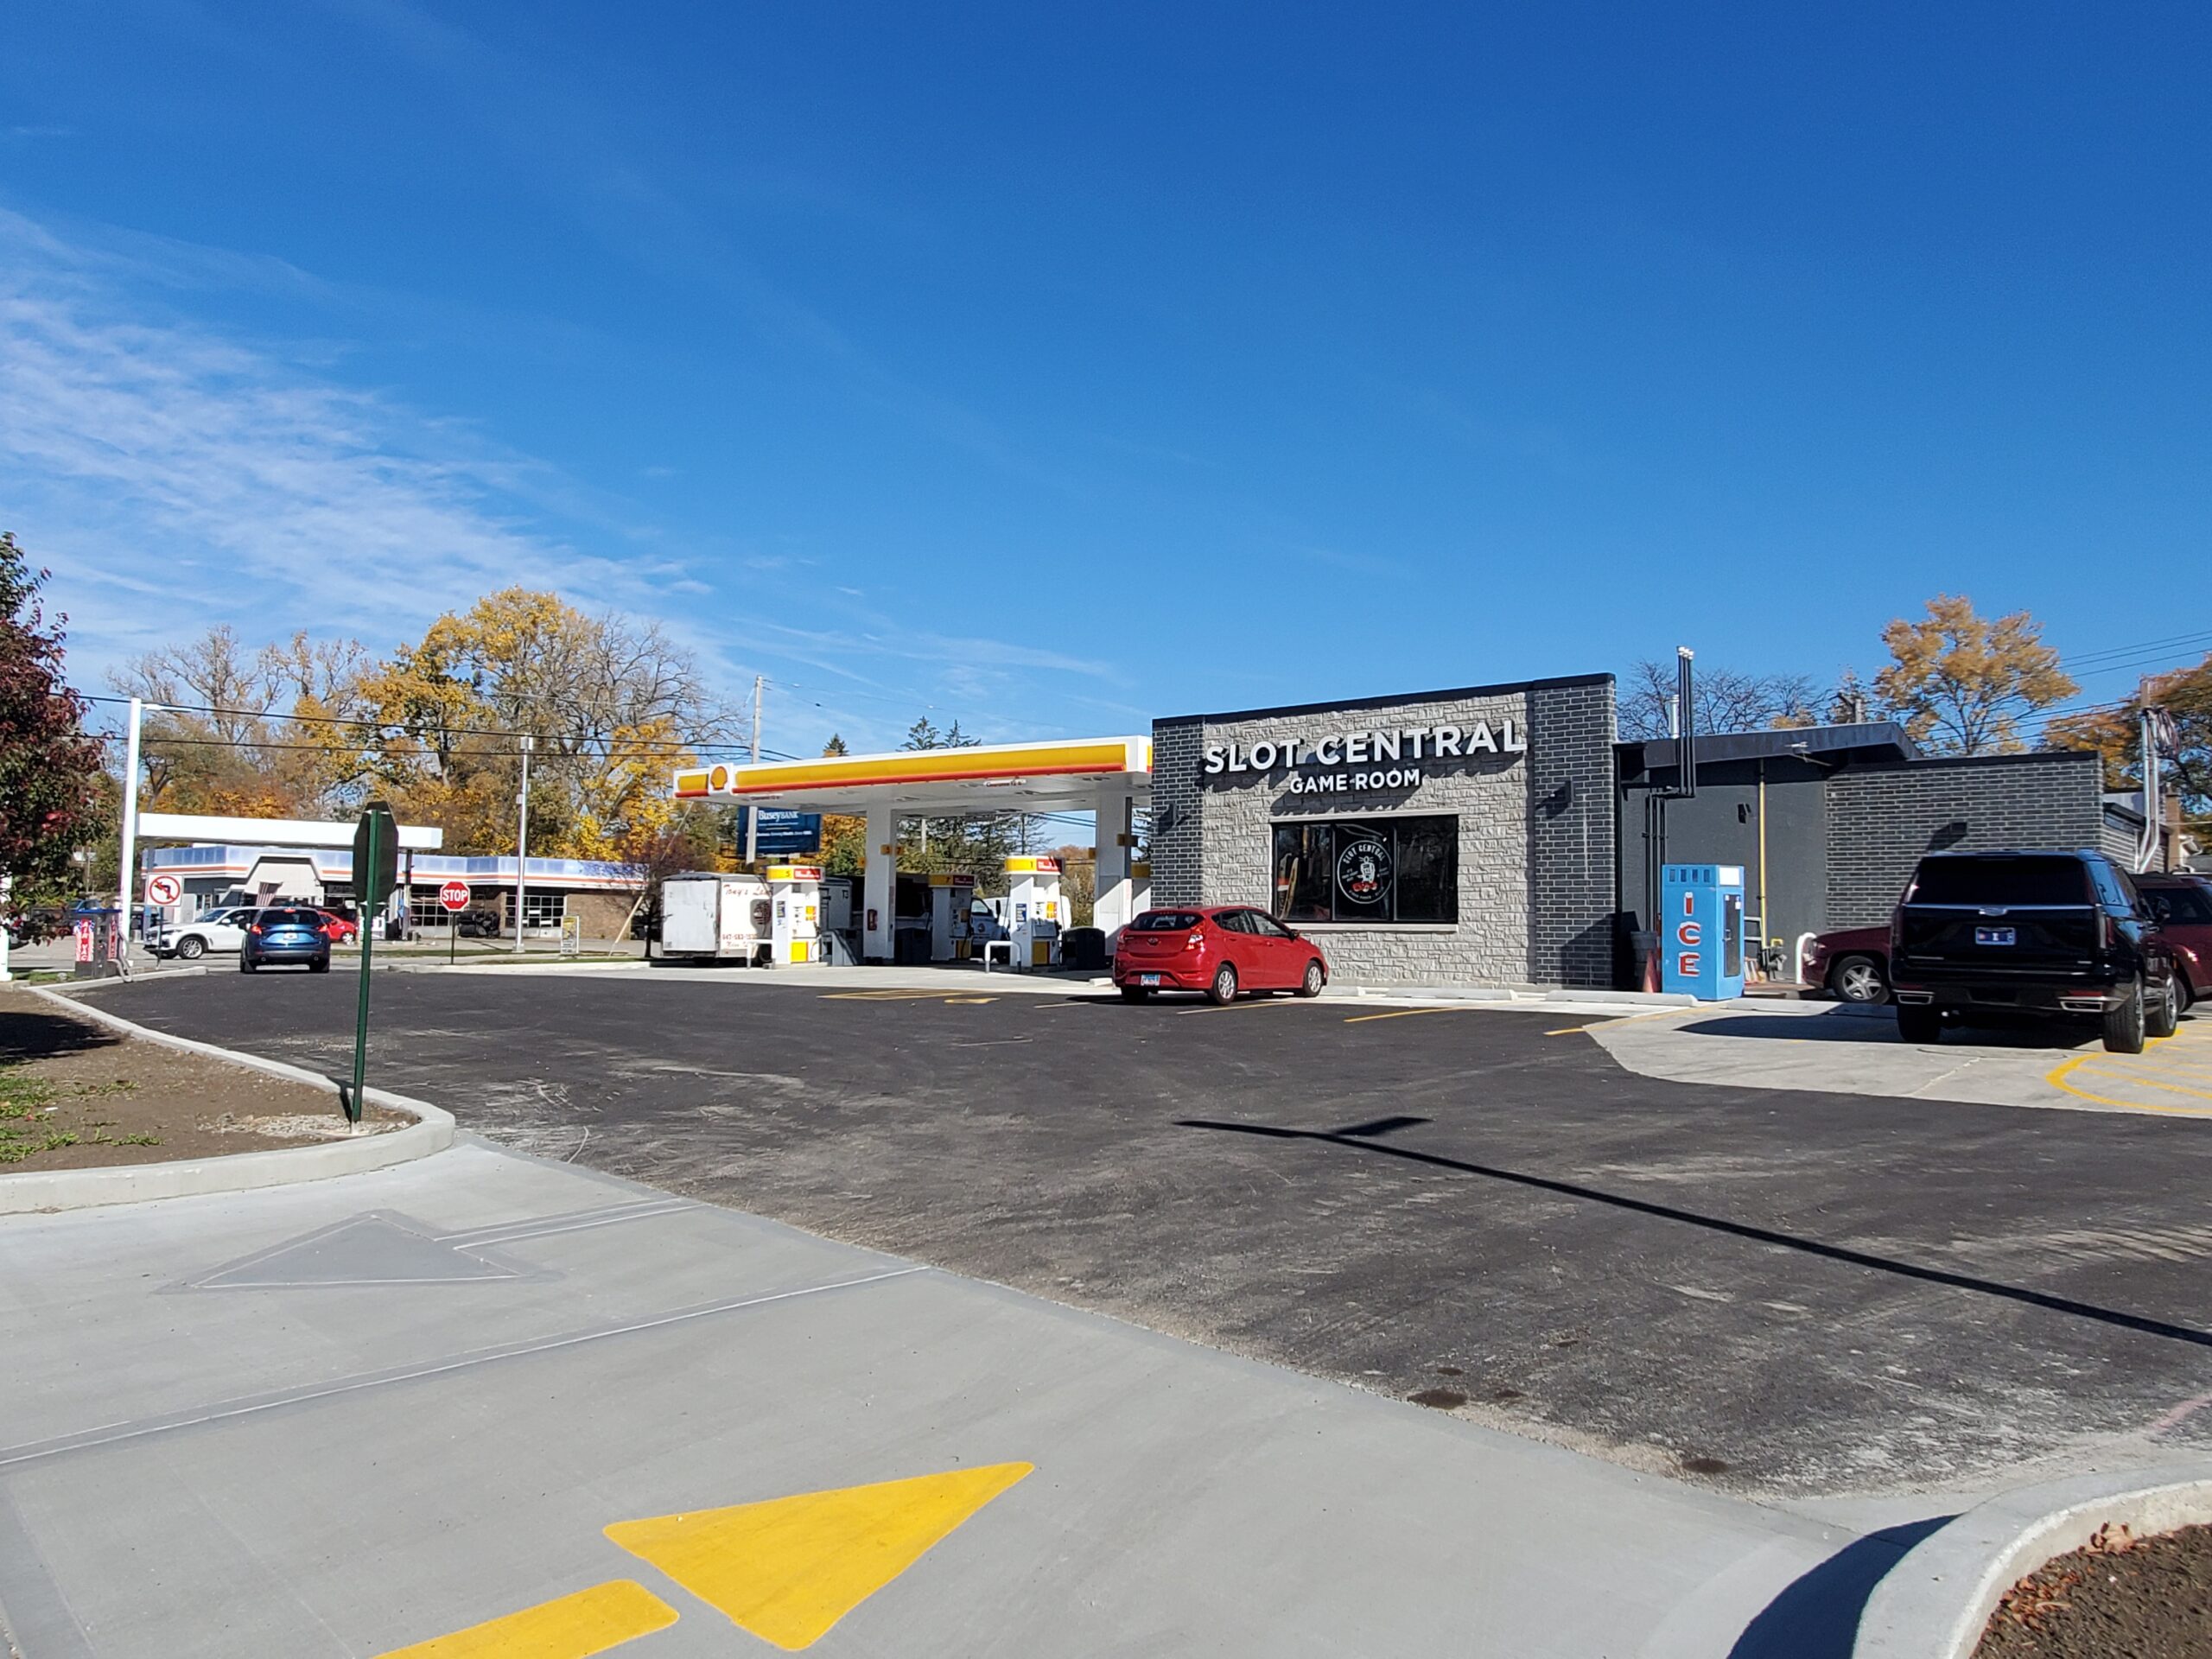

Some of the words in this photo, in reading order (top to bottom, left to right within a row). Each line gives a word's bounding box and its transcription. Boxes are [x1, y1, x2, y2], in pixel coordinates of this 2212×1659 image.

[1205, 738, 1300, 773] SLOT
[1316, 720, 1528, 766] CENTRAL
[1289, 774, 1347, 794] GAME
[1355, 768, 1420, 790] ROOM
[1343, 847, 1357, 864] SLOT
[1358, 844, 1386, 862] CENTRAL
[442, 888, 467, 902] STOP
[1677, 891, 1701, 977] ICE
